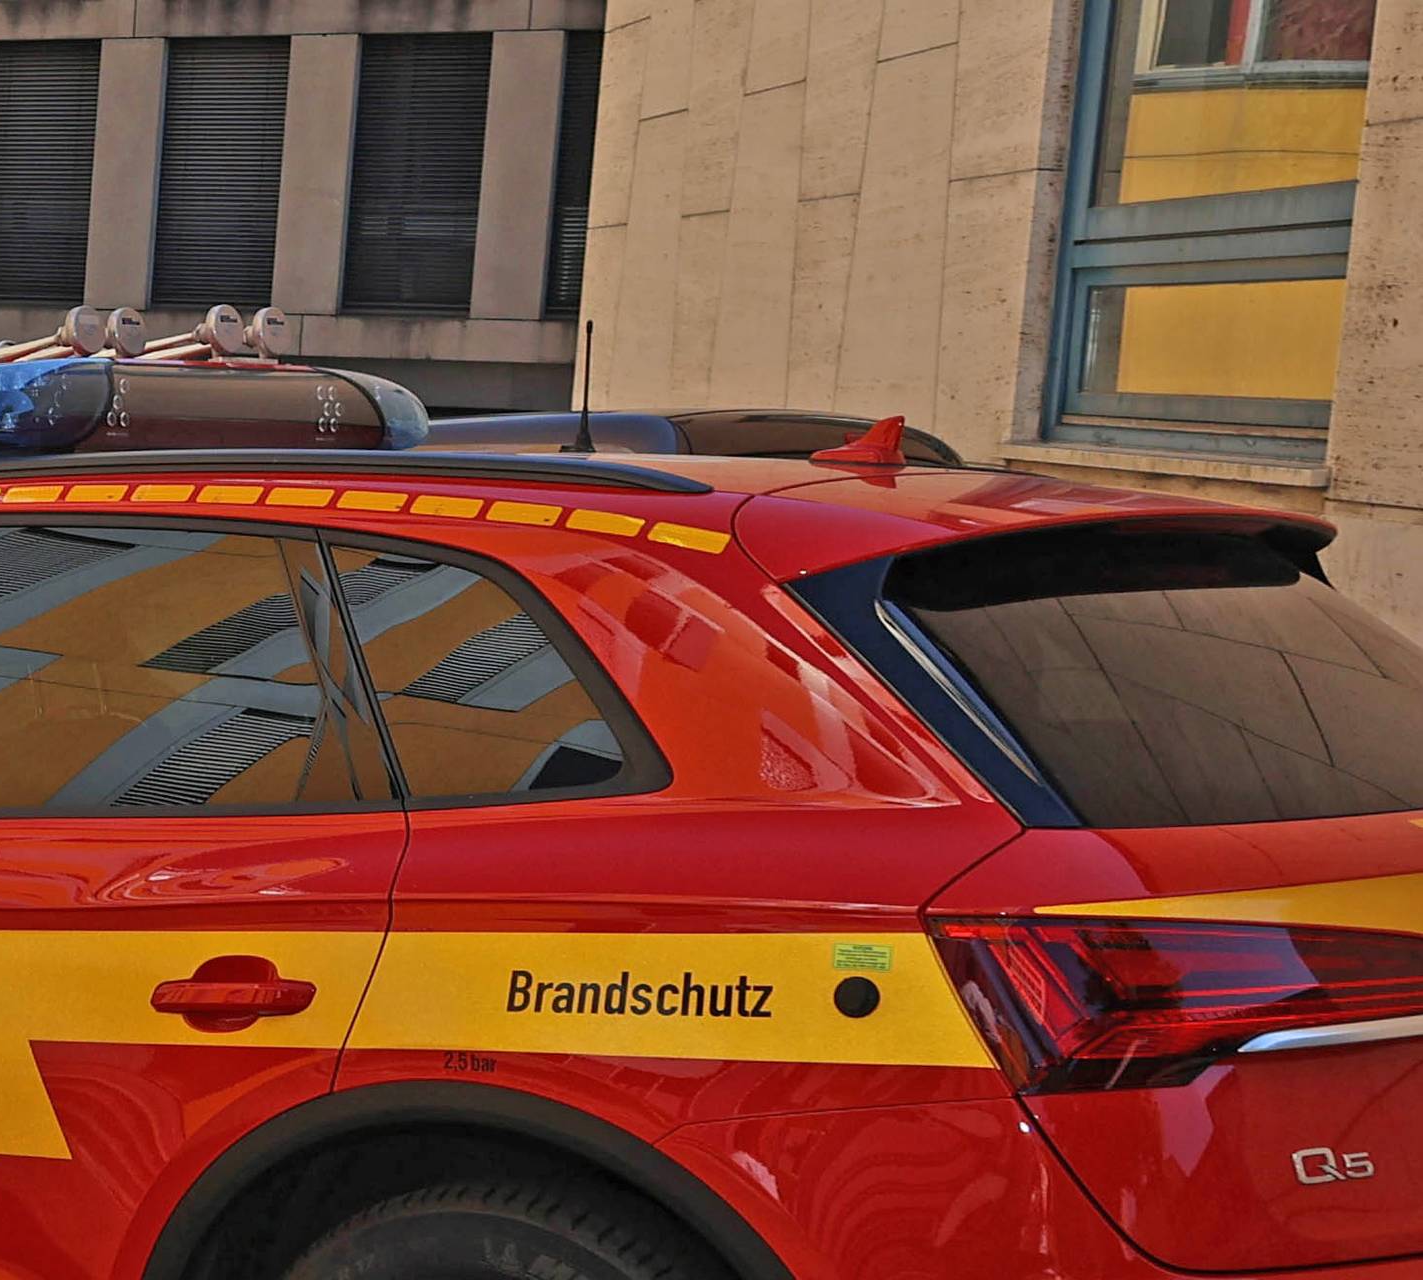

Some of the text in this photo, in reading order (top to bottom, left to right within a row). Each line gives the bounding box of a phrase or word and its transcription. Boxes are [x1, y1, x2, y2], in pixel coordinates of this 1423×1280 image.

[506, 970, 774, 1018] Brandschutz
[443, 1050, 497, 1073] 2,5 bar
[1291, 1147, 1375, 1185] Q5
